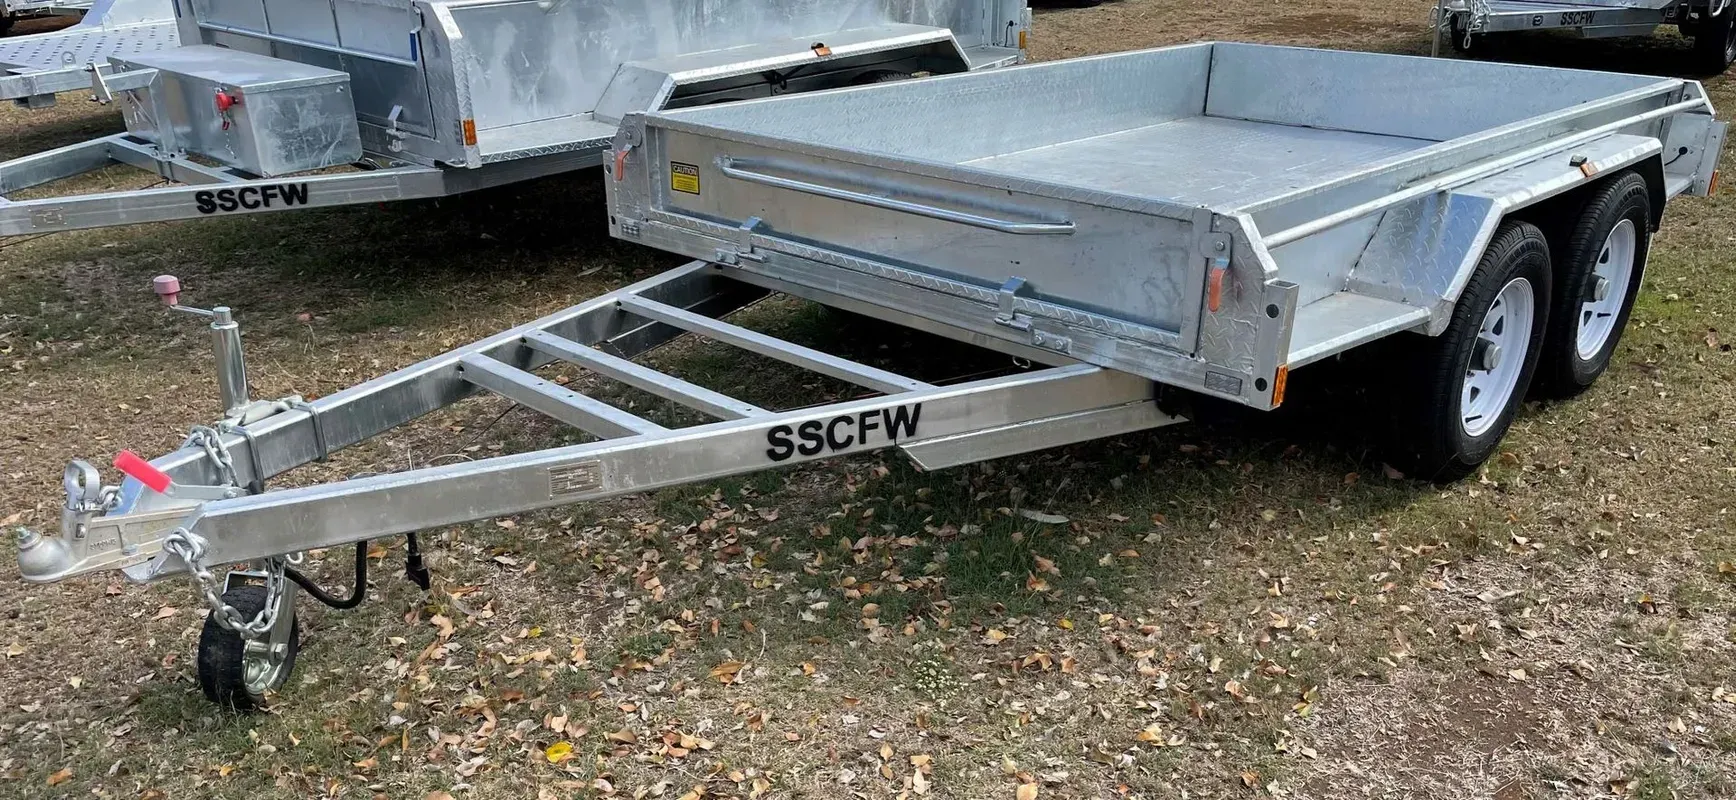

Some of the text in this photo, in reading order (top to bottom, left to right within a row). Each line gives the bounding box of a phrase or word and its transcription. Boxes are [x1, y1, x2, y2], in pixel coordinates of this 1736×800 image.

[1560, 11, 1595, 26] SSCFW
[195, 183, 308, 214] SSCFW
[766, 402, 922, 462] SSCFW
